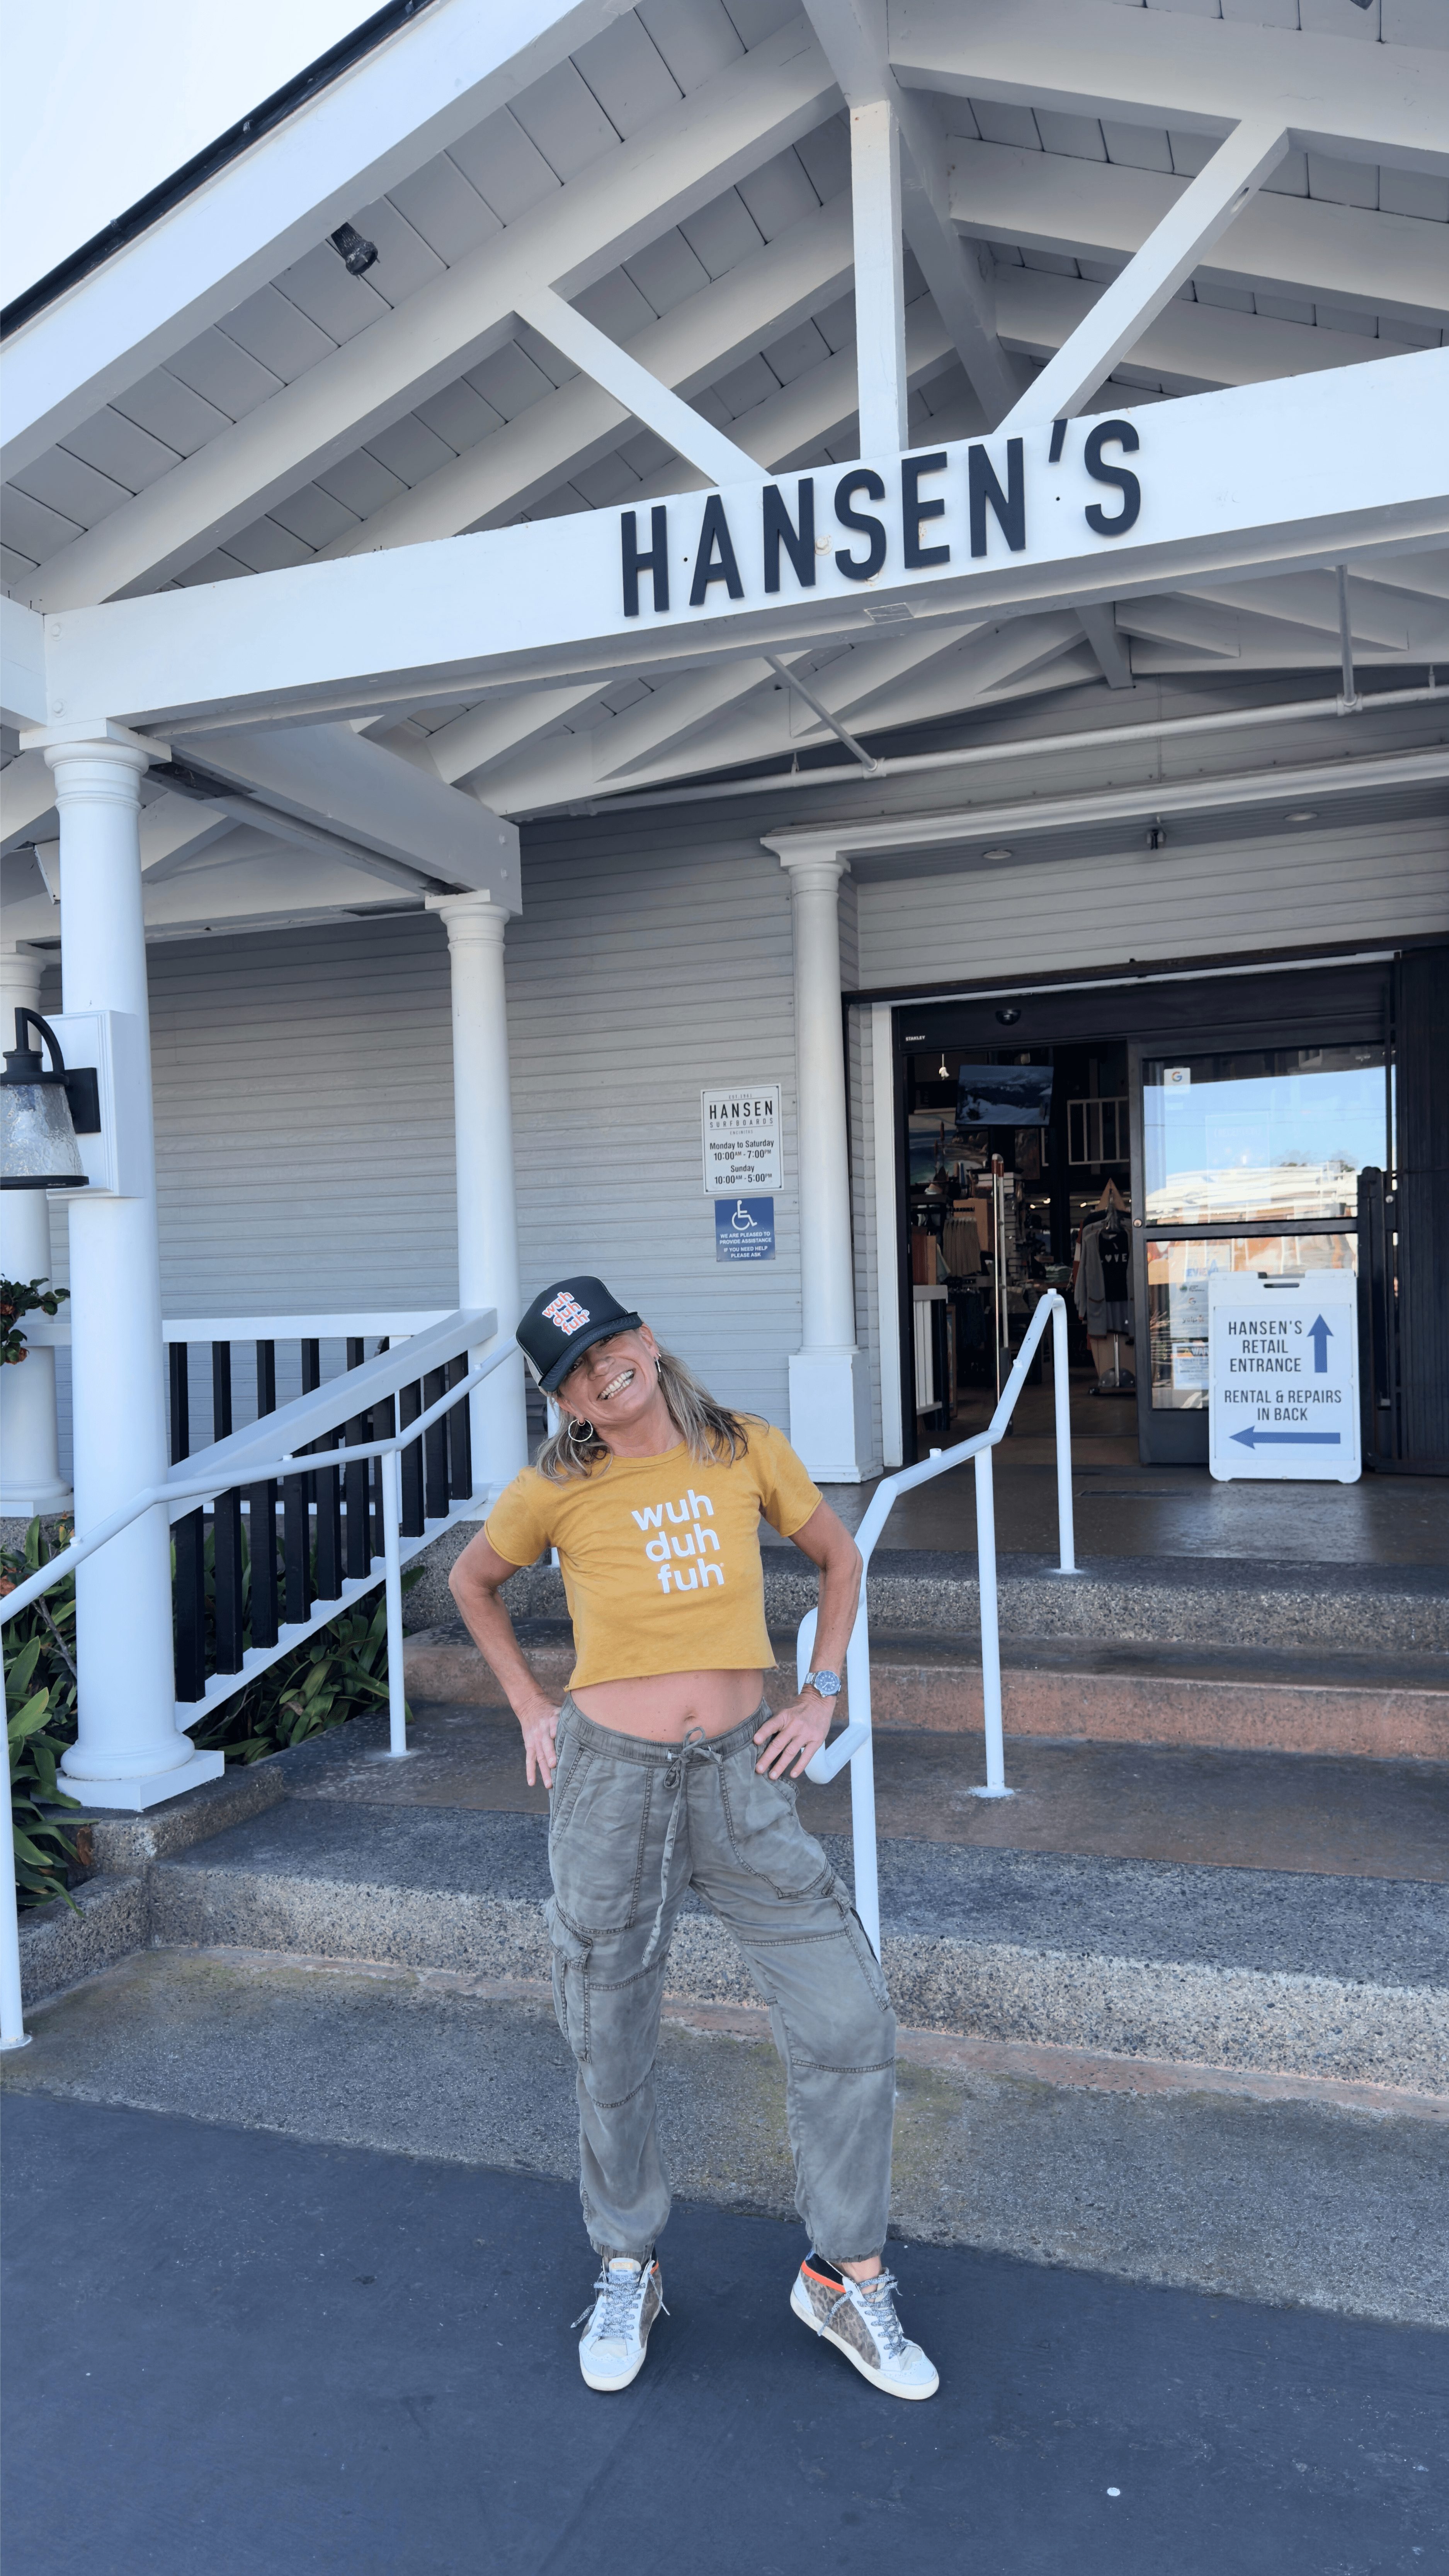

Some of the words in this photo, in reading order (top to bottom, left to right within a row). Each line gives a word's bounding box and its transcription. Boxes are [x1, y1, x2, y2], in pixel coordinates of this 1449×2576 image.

[621, 419, 1141, 617] HANSEN'S
[710, 1101, 772, 1119] HANSEN
[710, 1118, 773, 1128] SURFBOARDS
[710, 1142, 735, 1150] Monday
[745, 1139, 774, 1148] Saturday
[731, 1164, 754, 1173] Sunday
[543, 1293, 573, 1317] wuh
[554, 1303, 580, 1325] duh
[1228, 1320, 1303, 1335] HANSEN'S
[1242, 1339, 1288, 1353] RETAIL
[1230, 1358, 1301, 1372] ENTRANCE
[1225, 1390, 1271, 1403] RENTAL
[1276, 1391, 1284, 1403] &
[1288, 1390, 1342, 1403] REPAIRS
[1257, 1408, 1270, 1421] IN
[1275, 1408, 1308, 1421] BACK
[631, 1489, 714, 1531] wuh
[646, 1523, 720, 1562] duh
